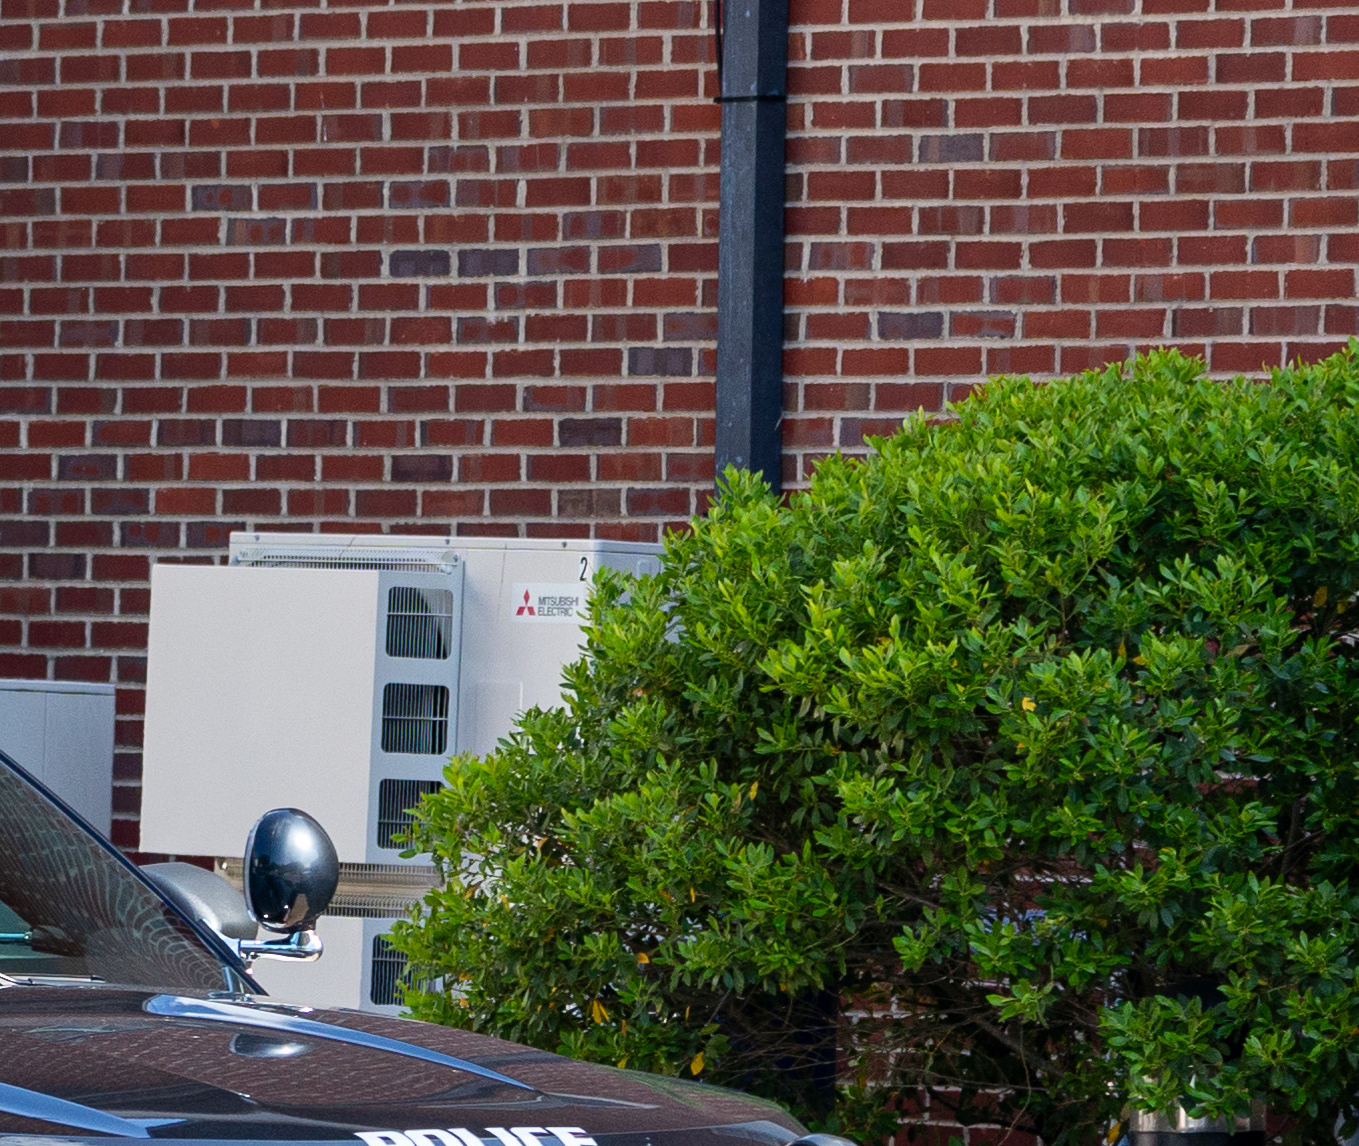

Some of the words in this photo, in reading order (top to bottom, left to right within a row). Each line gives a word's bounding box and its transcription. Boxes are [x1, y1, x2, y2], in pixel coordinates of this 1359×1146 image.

[579, 556, 587, 581] 2
[537, 596, 580, 606] MITSUBISHI
[537, 606, 574, 617] ELECTRIC
